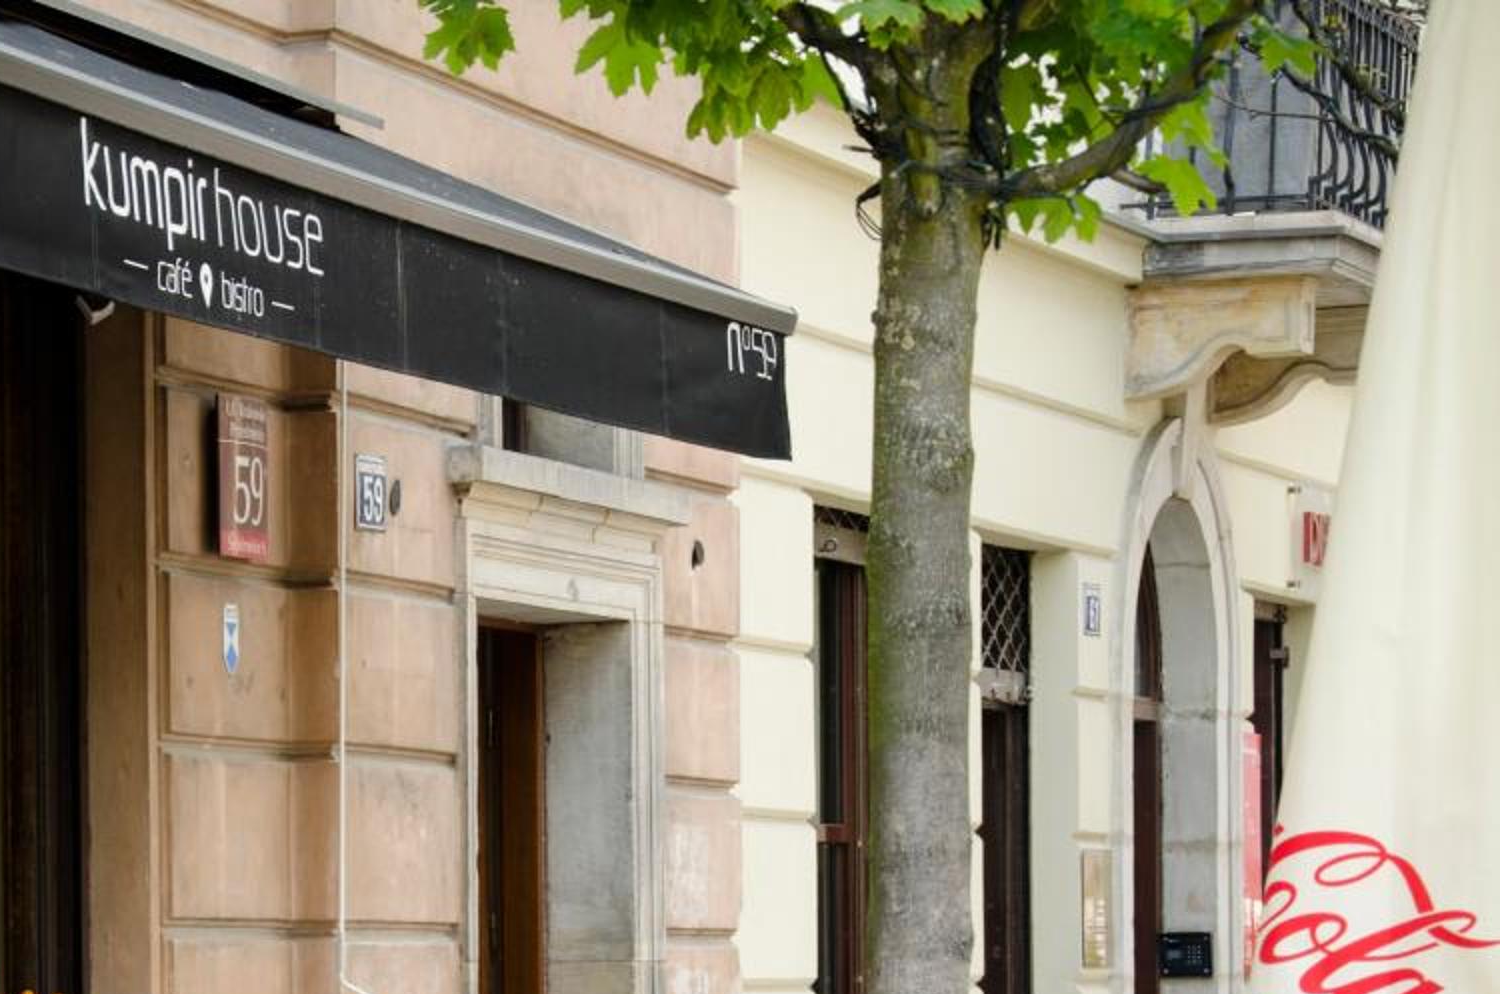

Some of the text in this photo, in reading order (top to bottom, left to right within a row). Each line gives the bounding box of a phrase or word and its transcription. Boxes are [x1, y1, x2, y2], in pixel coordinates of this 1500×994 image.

[156, 257, 264, 318] café bistro
[233, 455, 264, 526] 59
[363, 474, 383, 523] 59
